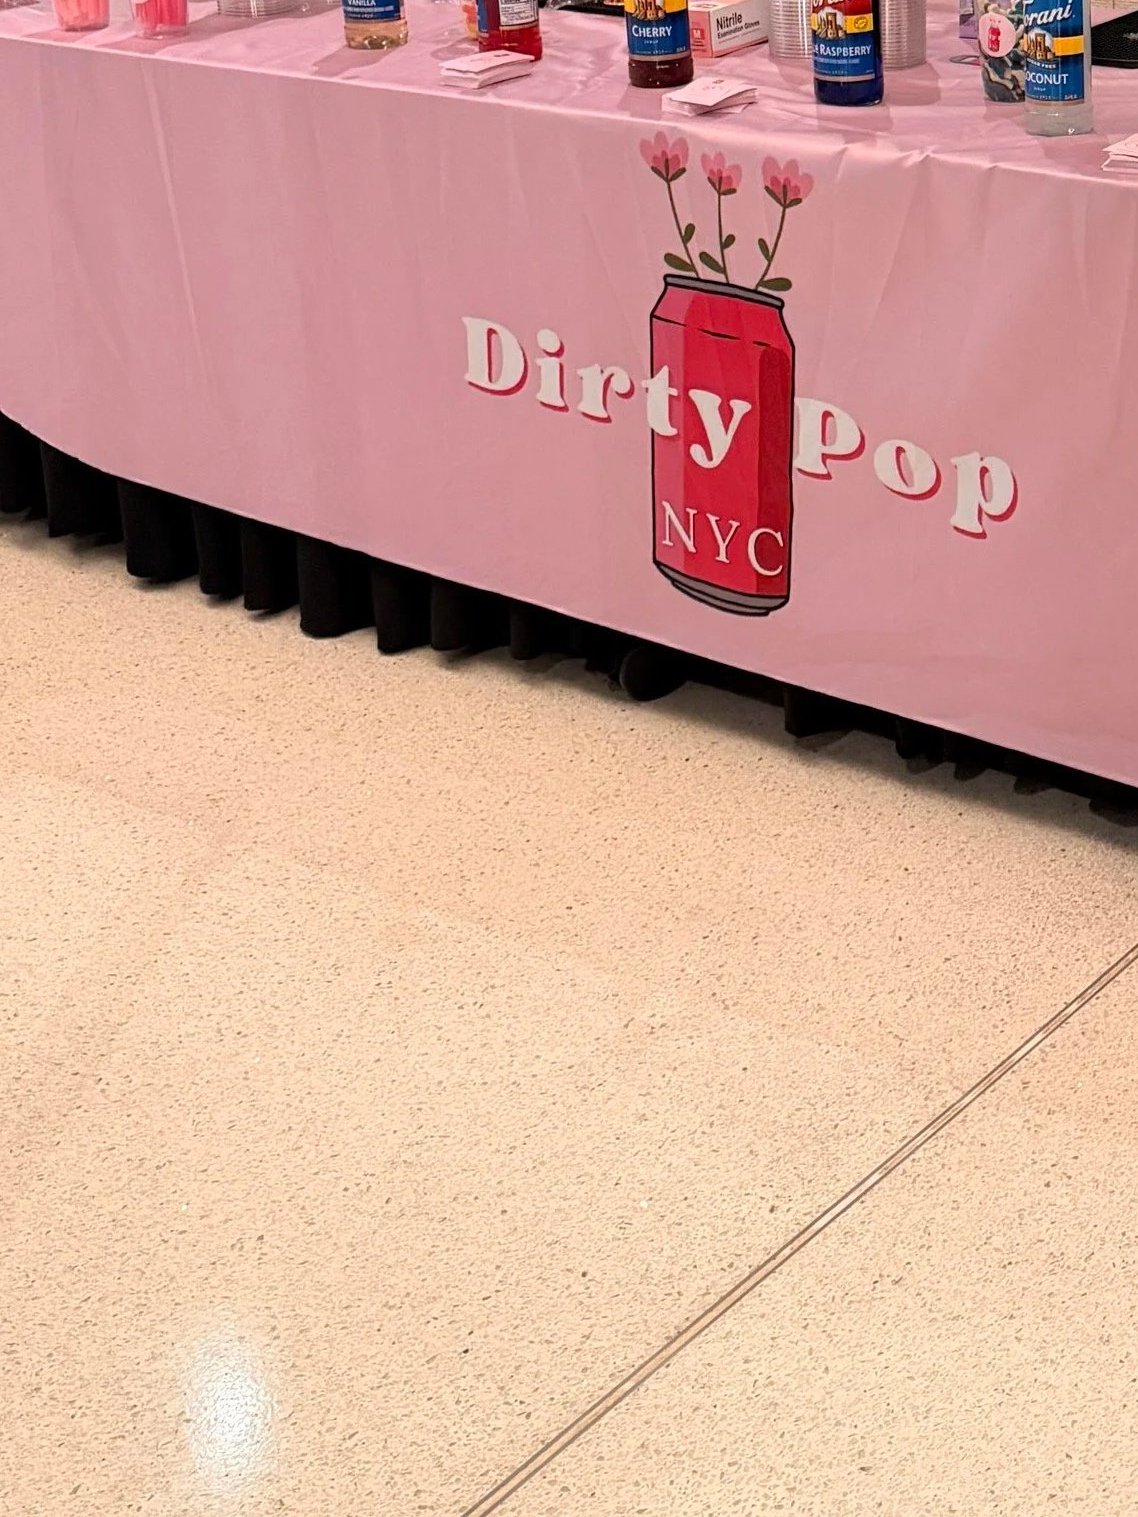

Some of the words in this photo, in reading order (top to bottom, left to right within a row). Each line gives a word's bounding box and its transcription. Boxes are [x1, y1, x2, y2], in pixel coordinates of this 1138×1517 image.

[716, 12, 743, 32] Nitrile
[632, 25, 673, 38] CHERRY
[819, 43, 872, 57] RASPBERRY
[1024, 69, 1069, 85] OCONUT
[461, 316, 752, 469] Dirty
[794, 396, 1019, 540] Pop
[661, 500, 786, 577] NYC
